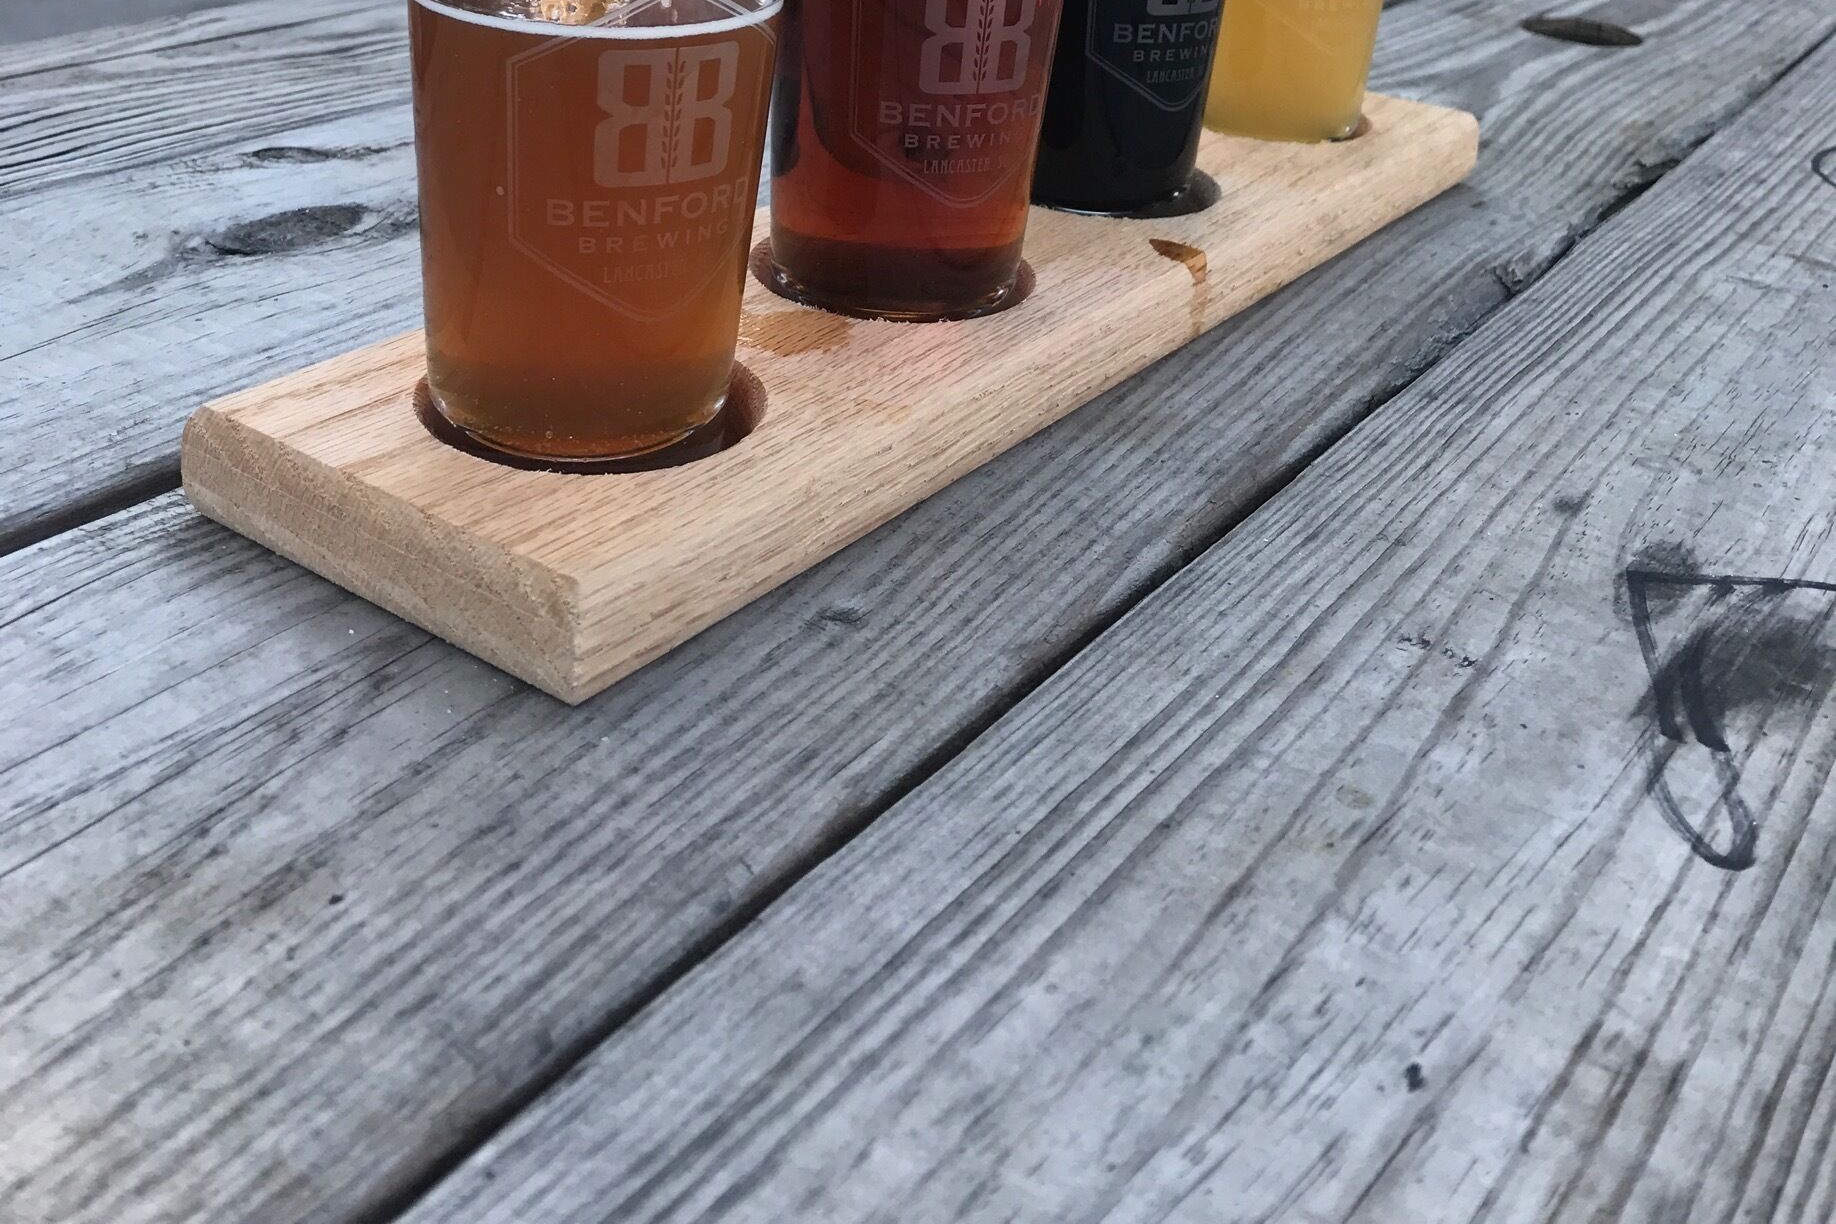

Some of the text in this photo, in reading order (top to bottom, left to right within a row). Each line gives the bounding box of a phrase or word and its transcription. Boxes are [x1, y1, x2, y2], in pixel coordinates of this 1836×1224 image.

[1113, 17, 1219, 44] BENFOR
[1132, 43, 1209, 62] BREWIN
[879, 94, 1041, 128] BENFORD
[545, 177, 749, 228] BENFORD
[578, 218, 730, 255] BREWING
